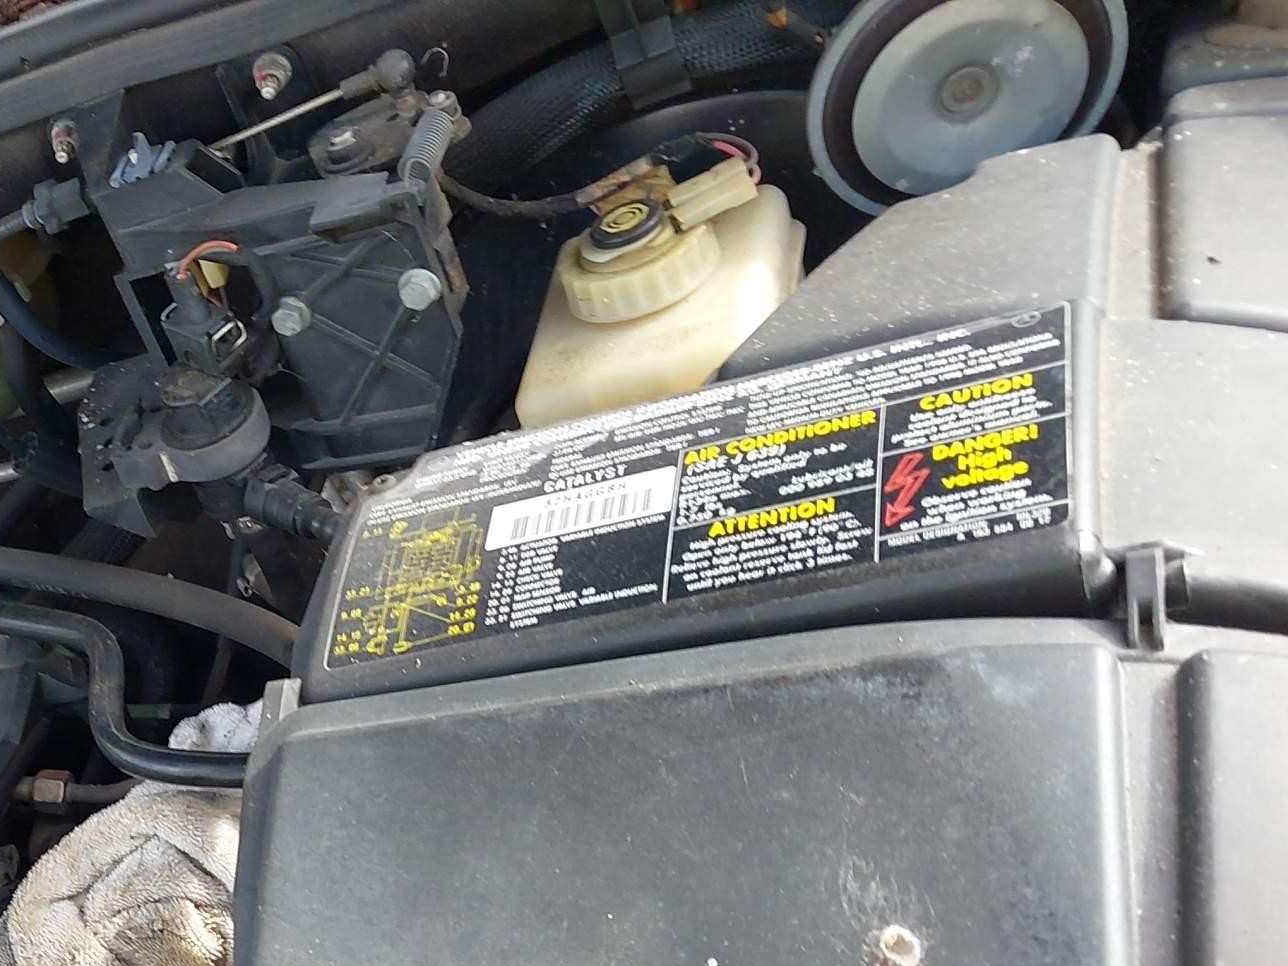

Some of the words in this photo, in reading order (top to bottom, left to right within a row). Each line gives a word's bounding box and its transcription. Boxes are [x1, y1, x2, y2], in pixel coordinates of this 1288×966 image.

[919, 372, 1033, 410] CAUTION
[685, 446, 720, 464] AIR
[726, 410, 877, 455] CONDITIONER
[814, 446, 828, 456] to
[830, 442, 847, 452] be
[932, 424, 1039, 461] DANGER!
[958, 446, 1013, 470] High
[544, 464, 628, 494] CATALYST
[941, 461, 1029, 489] voltage
[708, 498, 835, 537] ATTENTION
